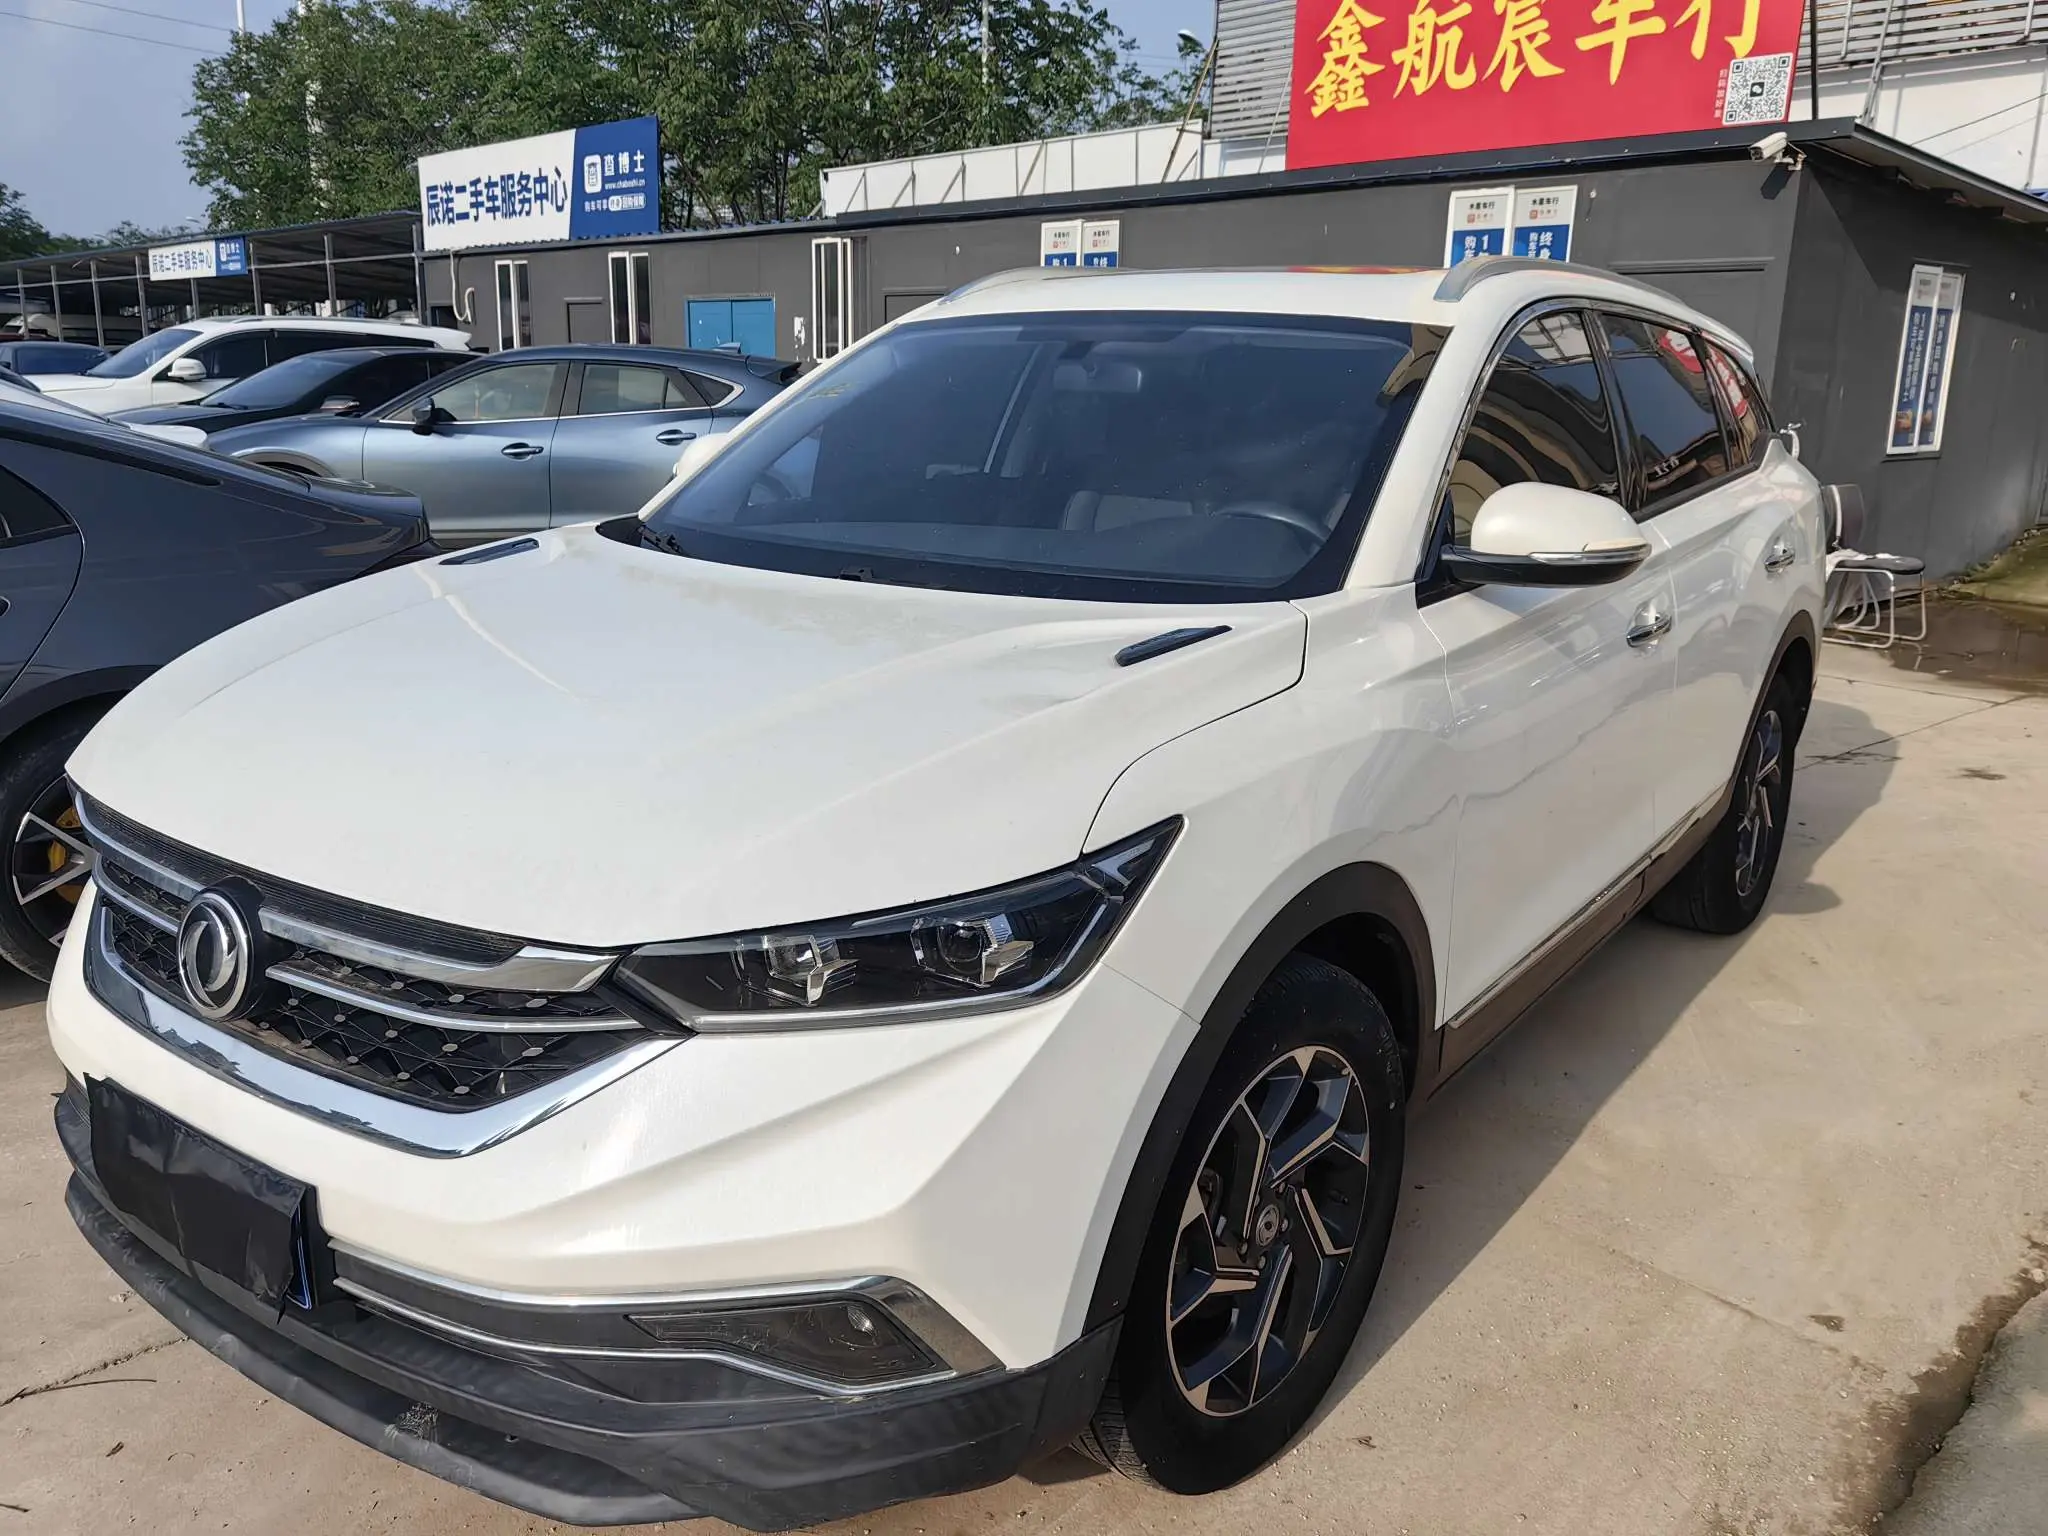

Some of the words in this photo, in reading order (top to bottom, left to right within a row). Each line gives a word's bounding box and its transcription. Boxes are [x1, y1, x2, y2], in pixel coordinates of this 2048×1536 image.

[603, 149, 645, 176] 查博士
[426, 166, 568, 227] 辰诺二手车服务中心
